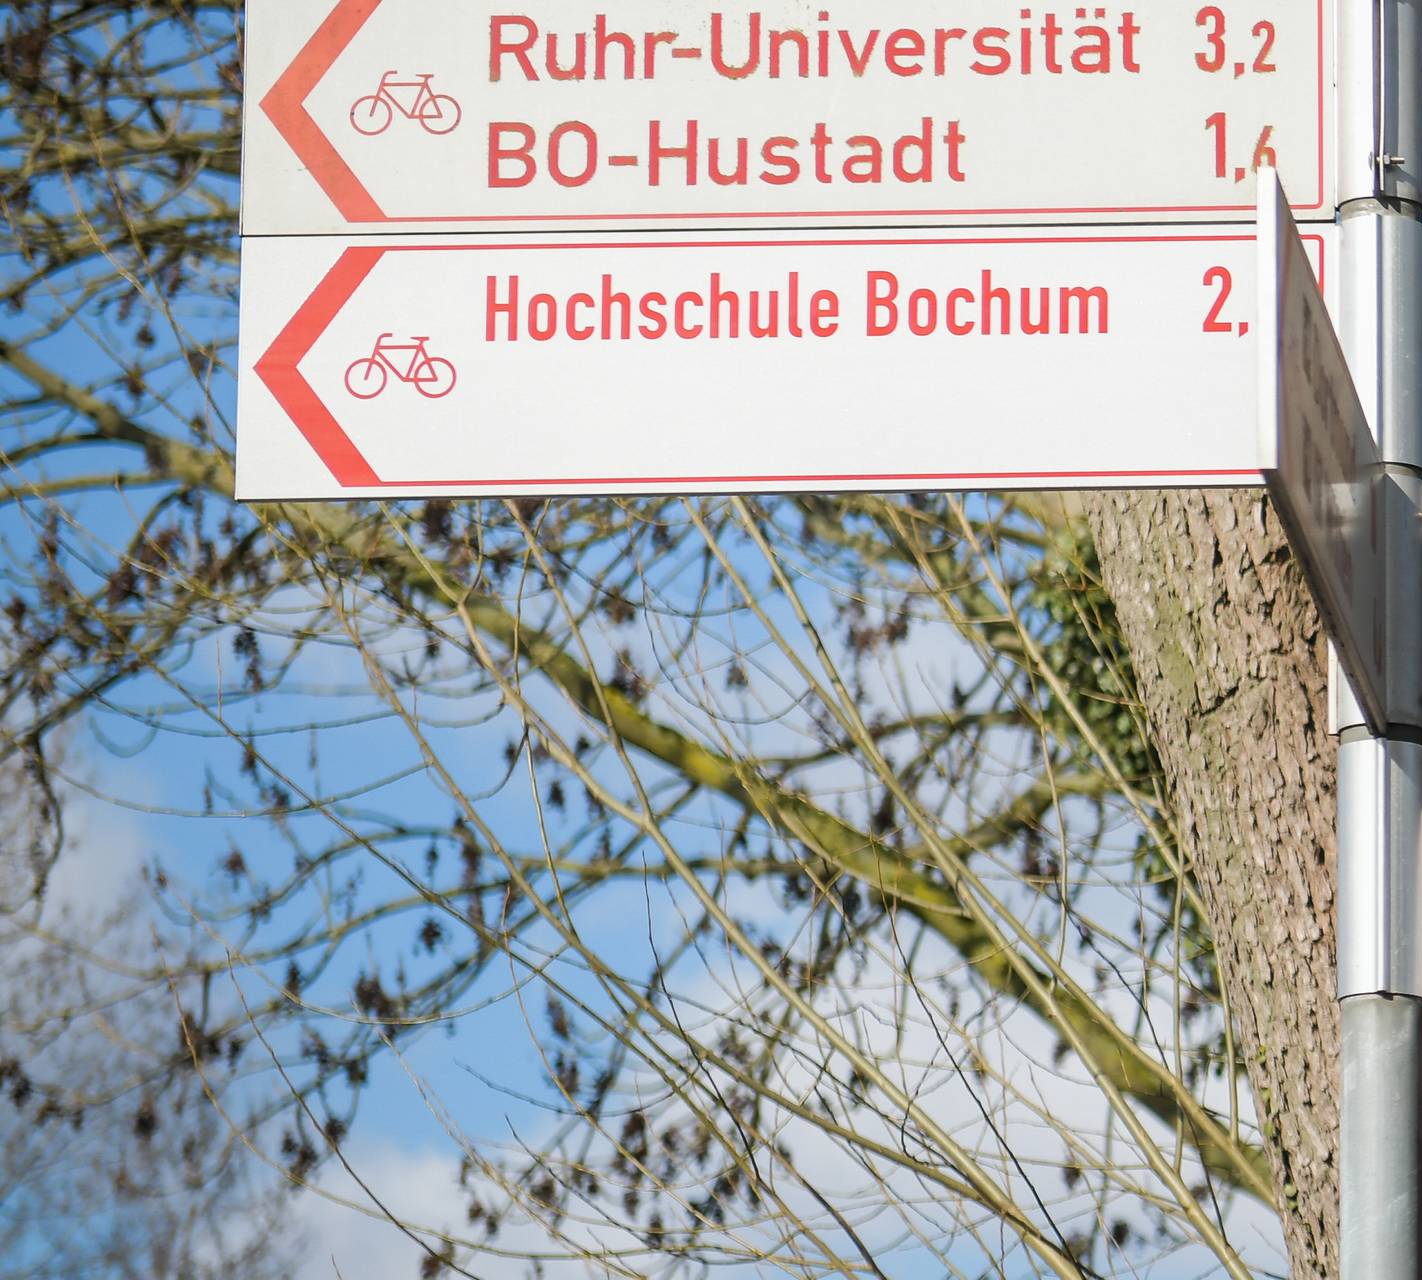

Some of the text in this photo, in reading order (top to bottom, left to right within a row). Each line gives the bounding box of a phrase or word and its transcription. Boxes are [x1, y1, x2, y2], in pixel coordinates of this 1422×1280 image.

[488, 6, 1277, 81] Ruhr-Universität 3,2
[487, 116, 967, 188] BO-Hustadt
[485, 266, 1250, 341] Hochschule Bochum 2,
